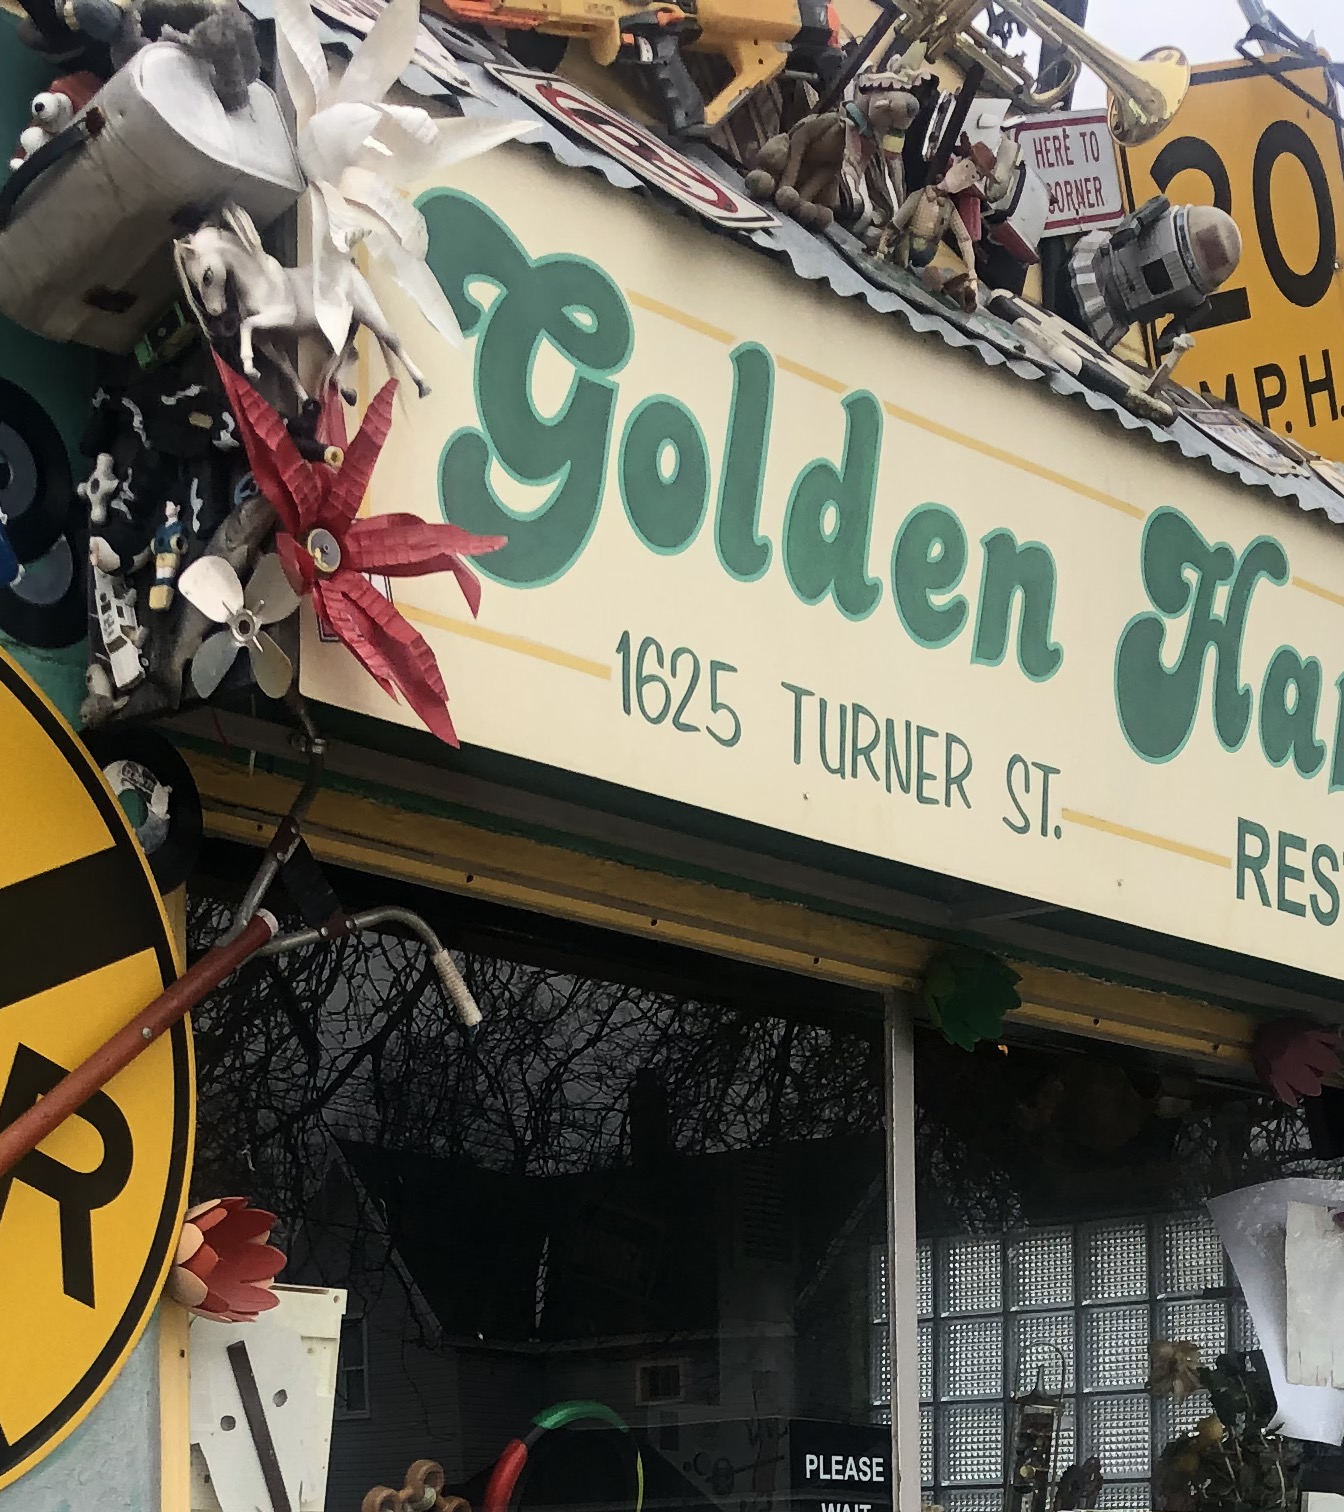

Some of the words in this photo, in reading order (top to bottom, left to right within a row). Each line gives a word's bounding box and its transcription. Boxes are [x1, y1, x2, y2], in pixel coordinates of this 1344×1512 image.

[1032, 129, 1075, 170] HERE
[1079, 130, 1100, 163] TO
[1149, 120, 1337, 334] 20
[413, 186, 1064, 683] Golden
[616, 630, 742, 747] 1625
[780, 680, 973, 809] TURNER
[1001, 753, 1063, 840] ST.
[806, 1455, 884, 1481] PLEASE
